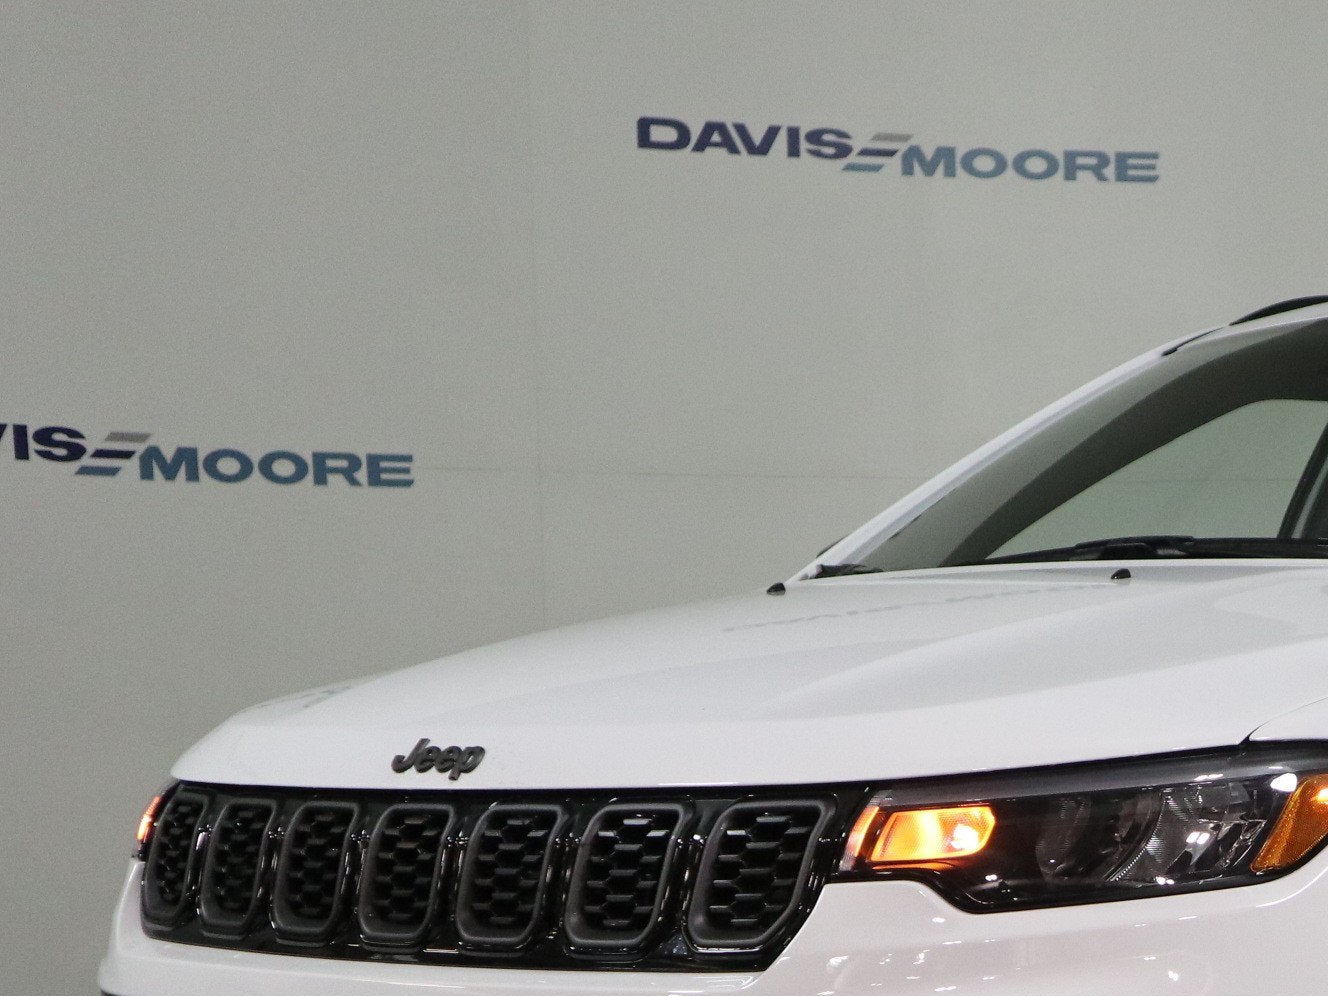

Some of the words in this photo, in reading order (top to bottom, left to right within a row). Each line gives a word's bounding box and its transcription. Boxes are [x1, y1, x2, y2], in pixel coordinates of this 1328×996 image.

[636, 116, 853, 160] DAVIS
[900, 144, 1160, 183] MOORE
[138, 445, 415, 487] MOORE
[391, 738, 485, 781] Jeep
